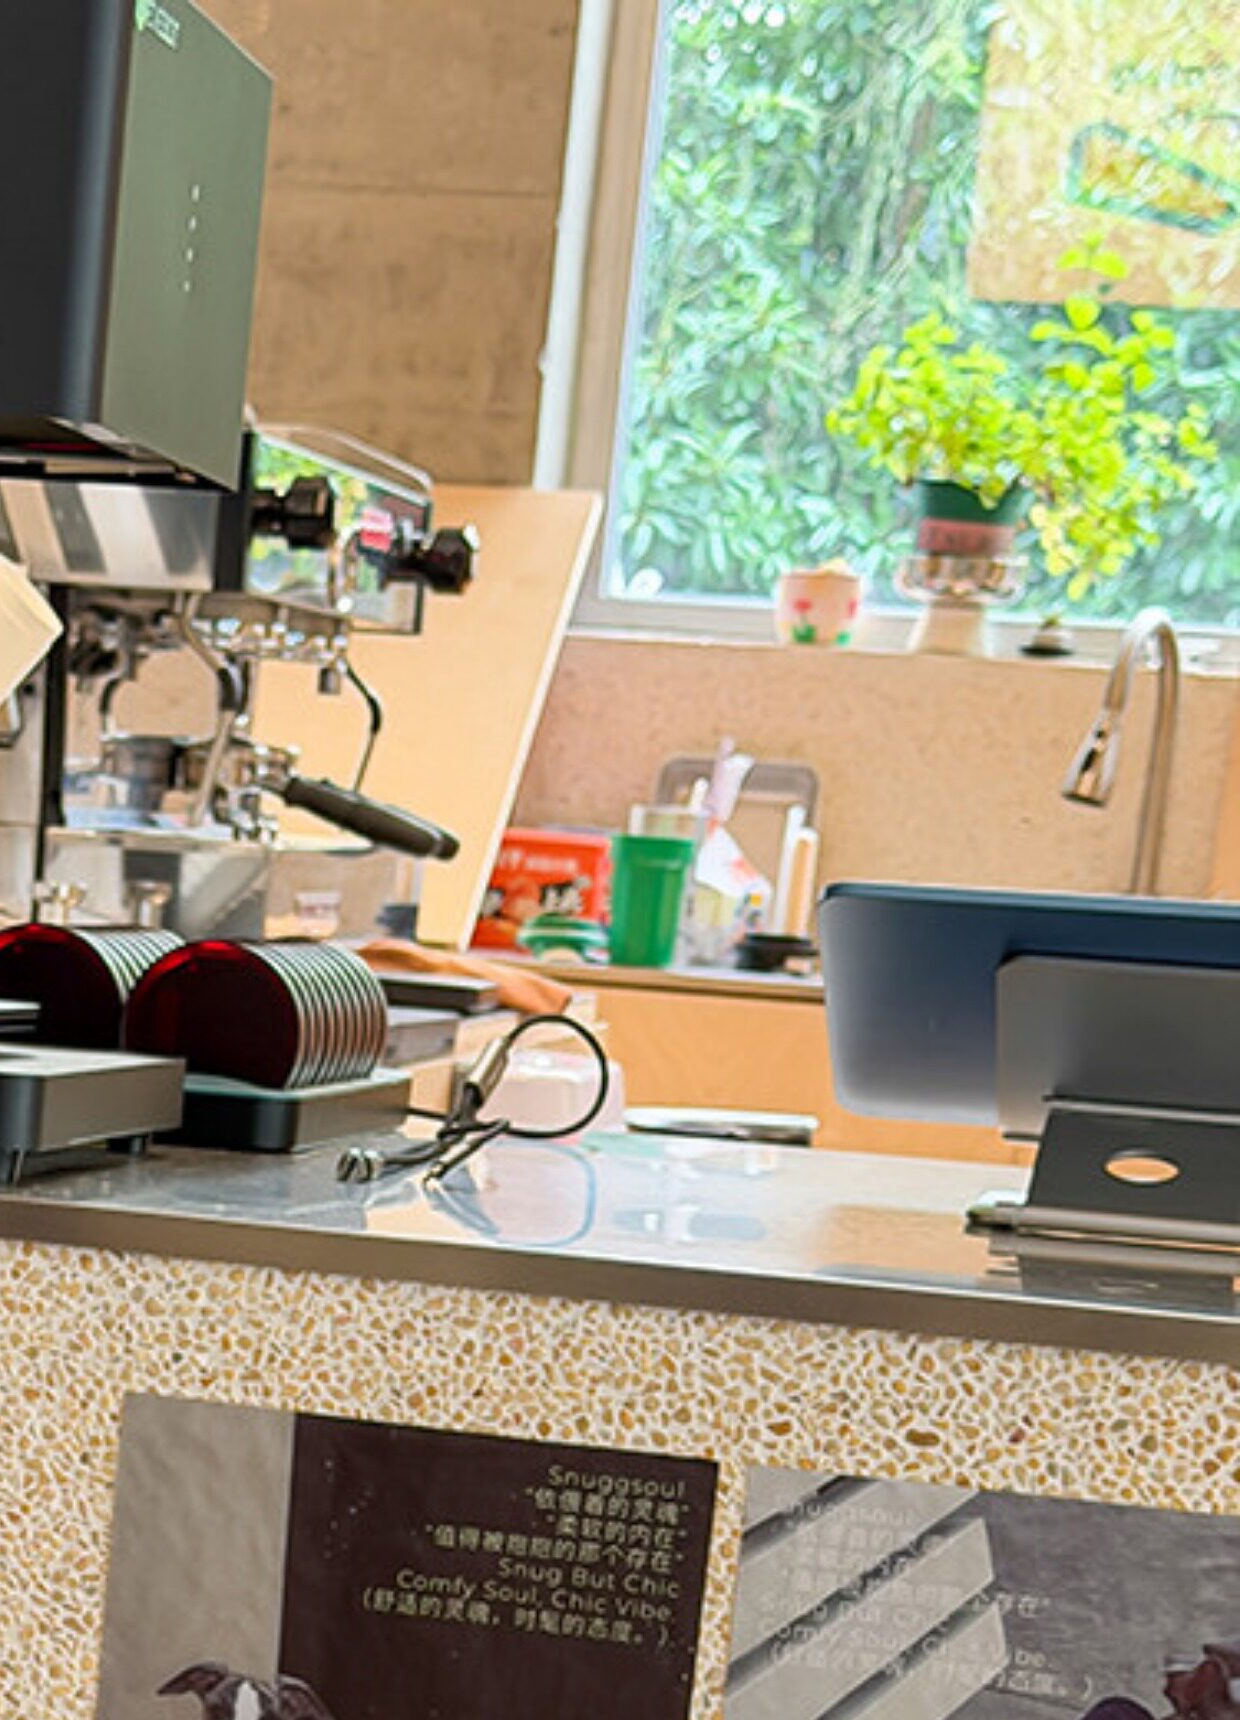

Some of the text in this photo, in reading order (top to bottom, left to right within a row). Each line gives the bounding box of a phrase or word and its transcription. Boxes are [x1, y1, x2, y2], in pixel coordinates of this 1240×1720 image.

[548, 1465, 686, 1499] Snuggsoul
[396, 1568, 477, 1600] Comfy
[551, 1588, 609, 1614] Chic
[498, 1558, 681, 1599] Snug But Chic
